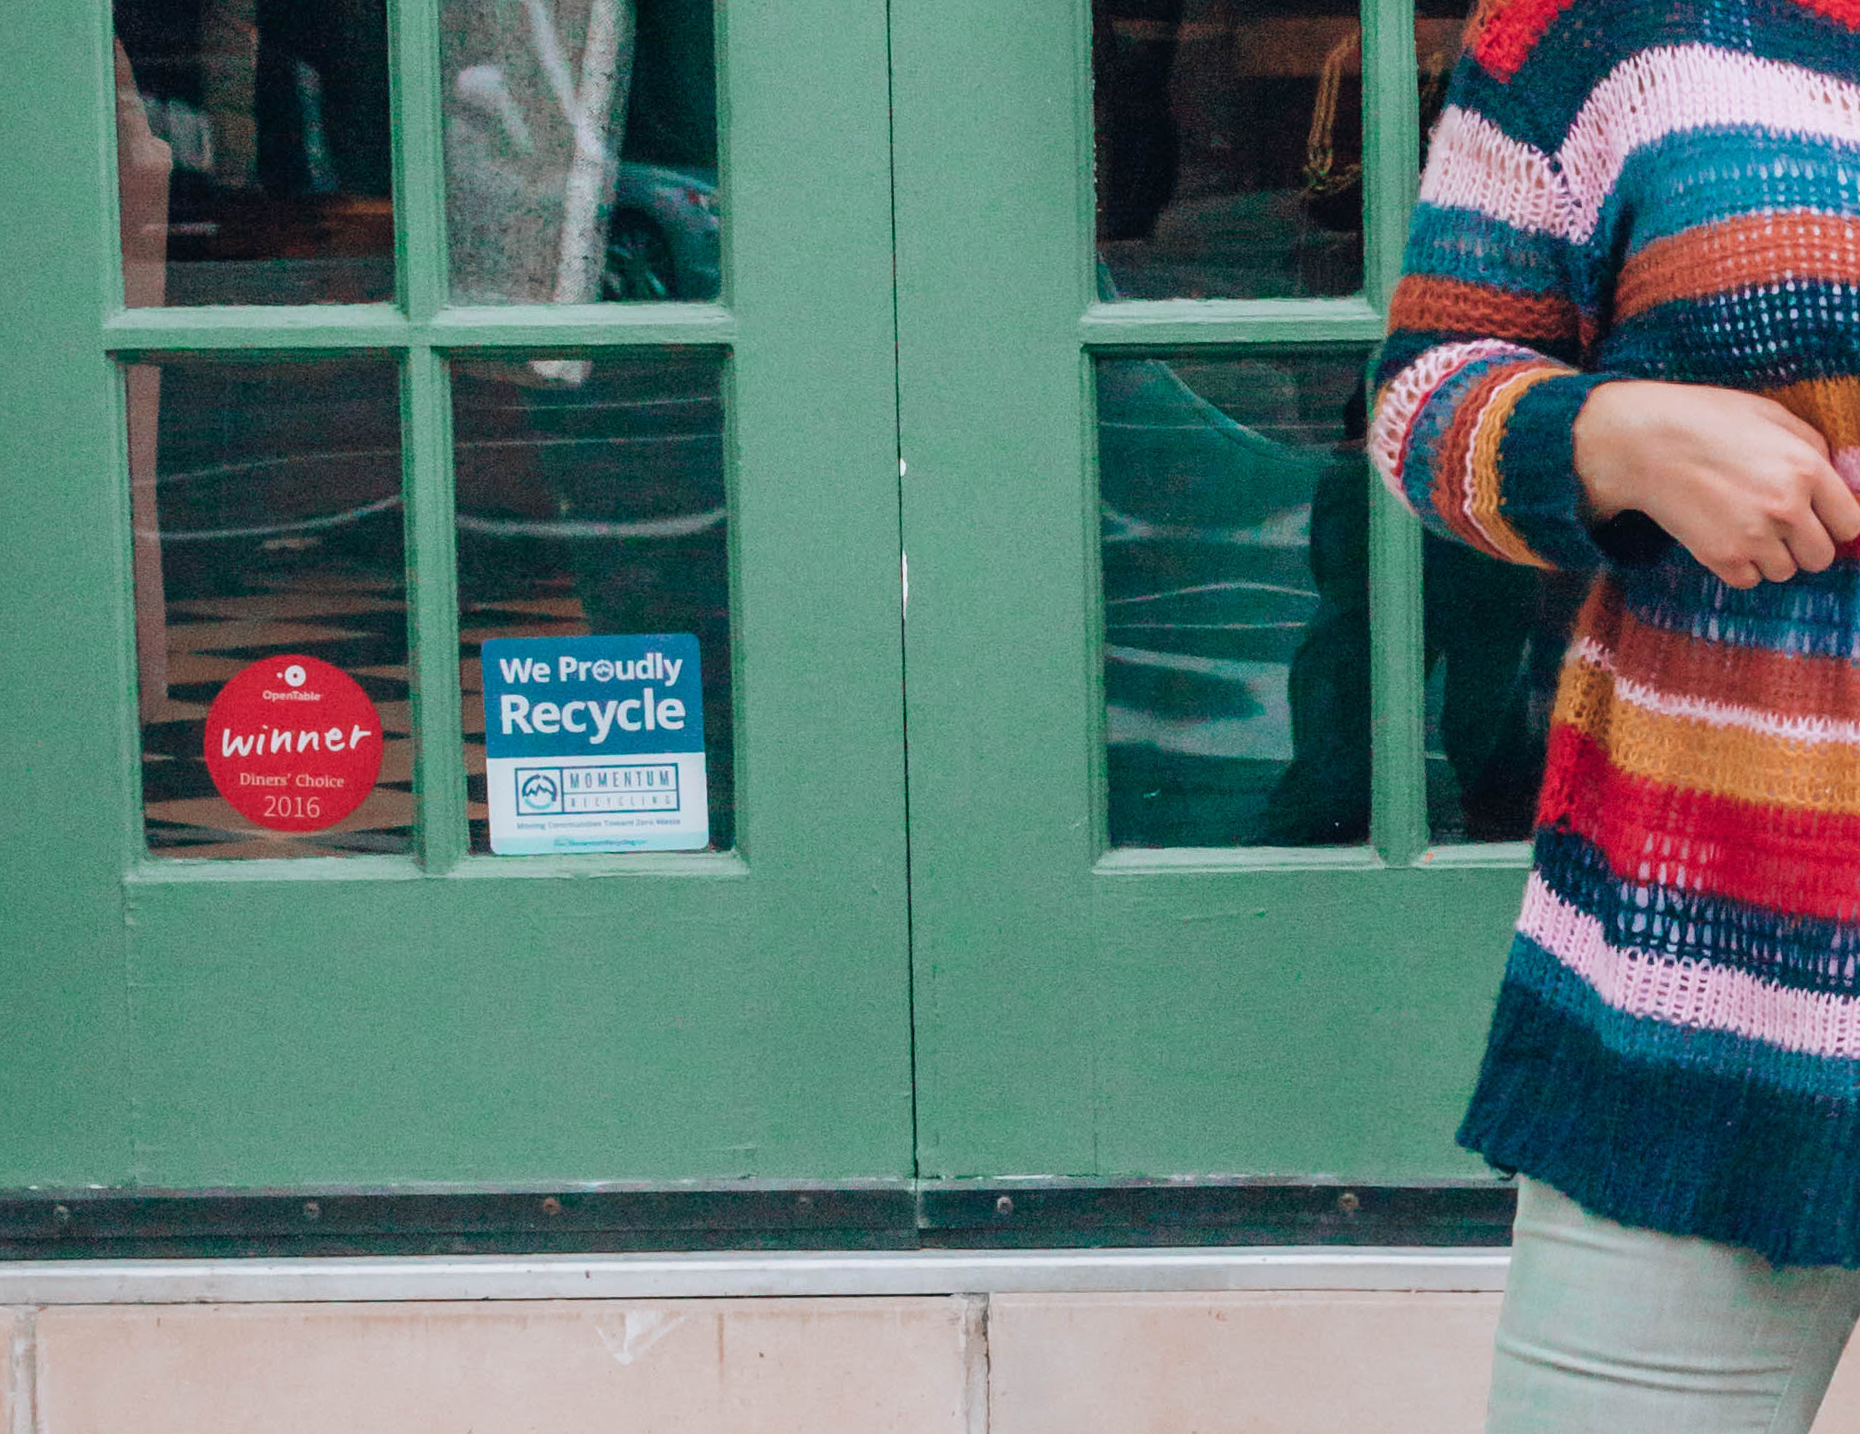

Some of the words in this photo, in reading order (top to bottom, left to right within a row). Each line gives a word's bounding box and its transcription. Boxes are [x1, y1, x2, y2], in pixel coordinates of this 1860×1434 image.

[500, 657, 551, 684] We
[558, 652, 683, 687] Proudly
[262, 689, 322, 703] OpenTable
[500, 687, 686, 745] Recycle
[222, 724, 371, 758] winner
[240, 773, 291, 787] Diners'
[295, 774, 345, 788] Choice
[570, 770, 670, 789] MOMENTUM
[264, 795, 321, 819] 2016
